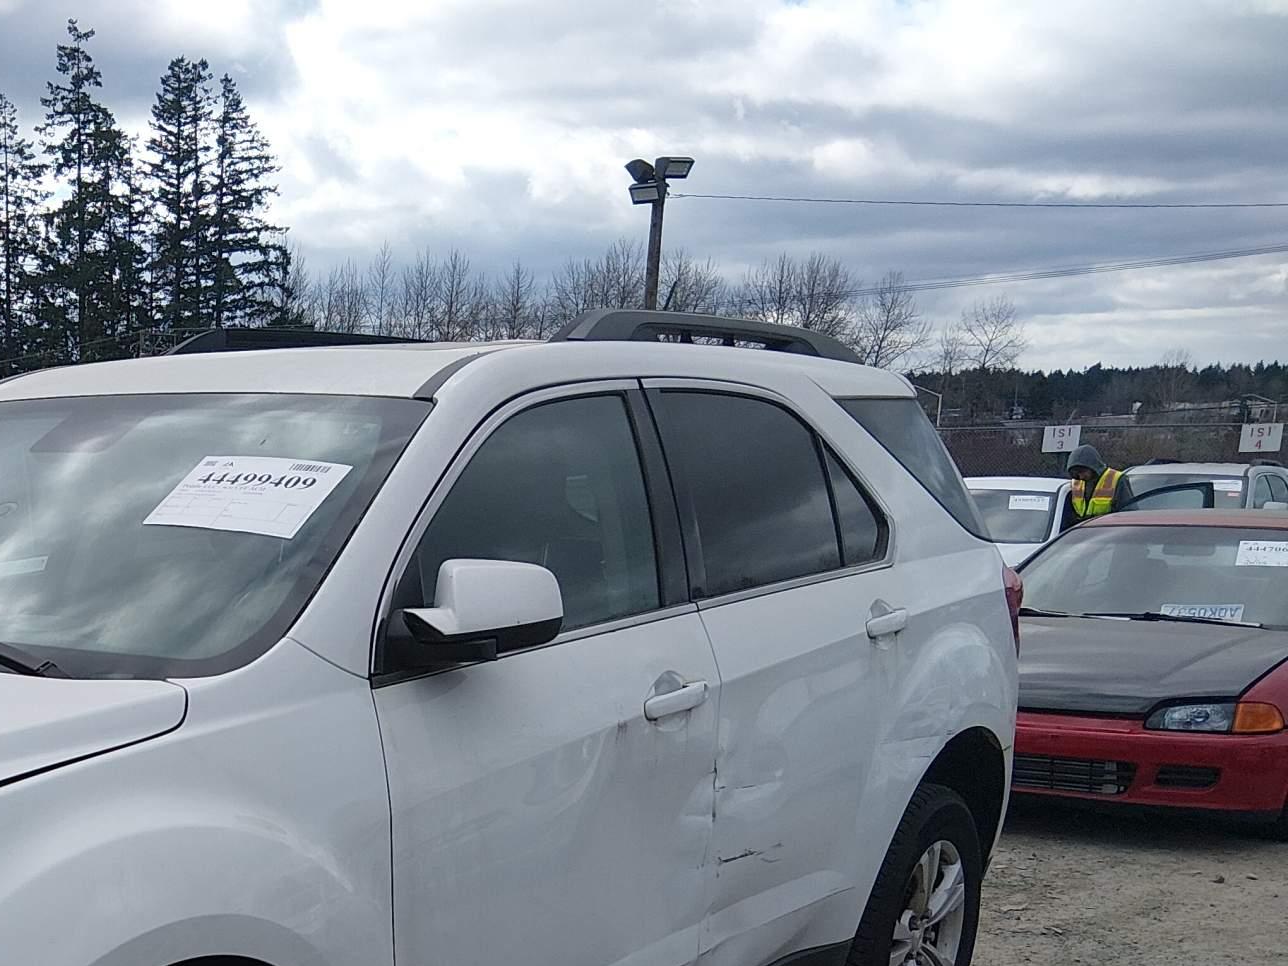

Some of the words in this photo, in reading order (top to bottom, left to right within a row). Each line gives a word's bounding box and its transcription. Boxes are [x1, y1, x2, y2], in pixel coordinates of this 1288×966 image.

[1056, 440, 1064, 450] 3
[1255, 439, 1262, 449] 4
[197, 471, 318, 490] 44499409
